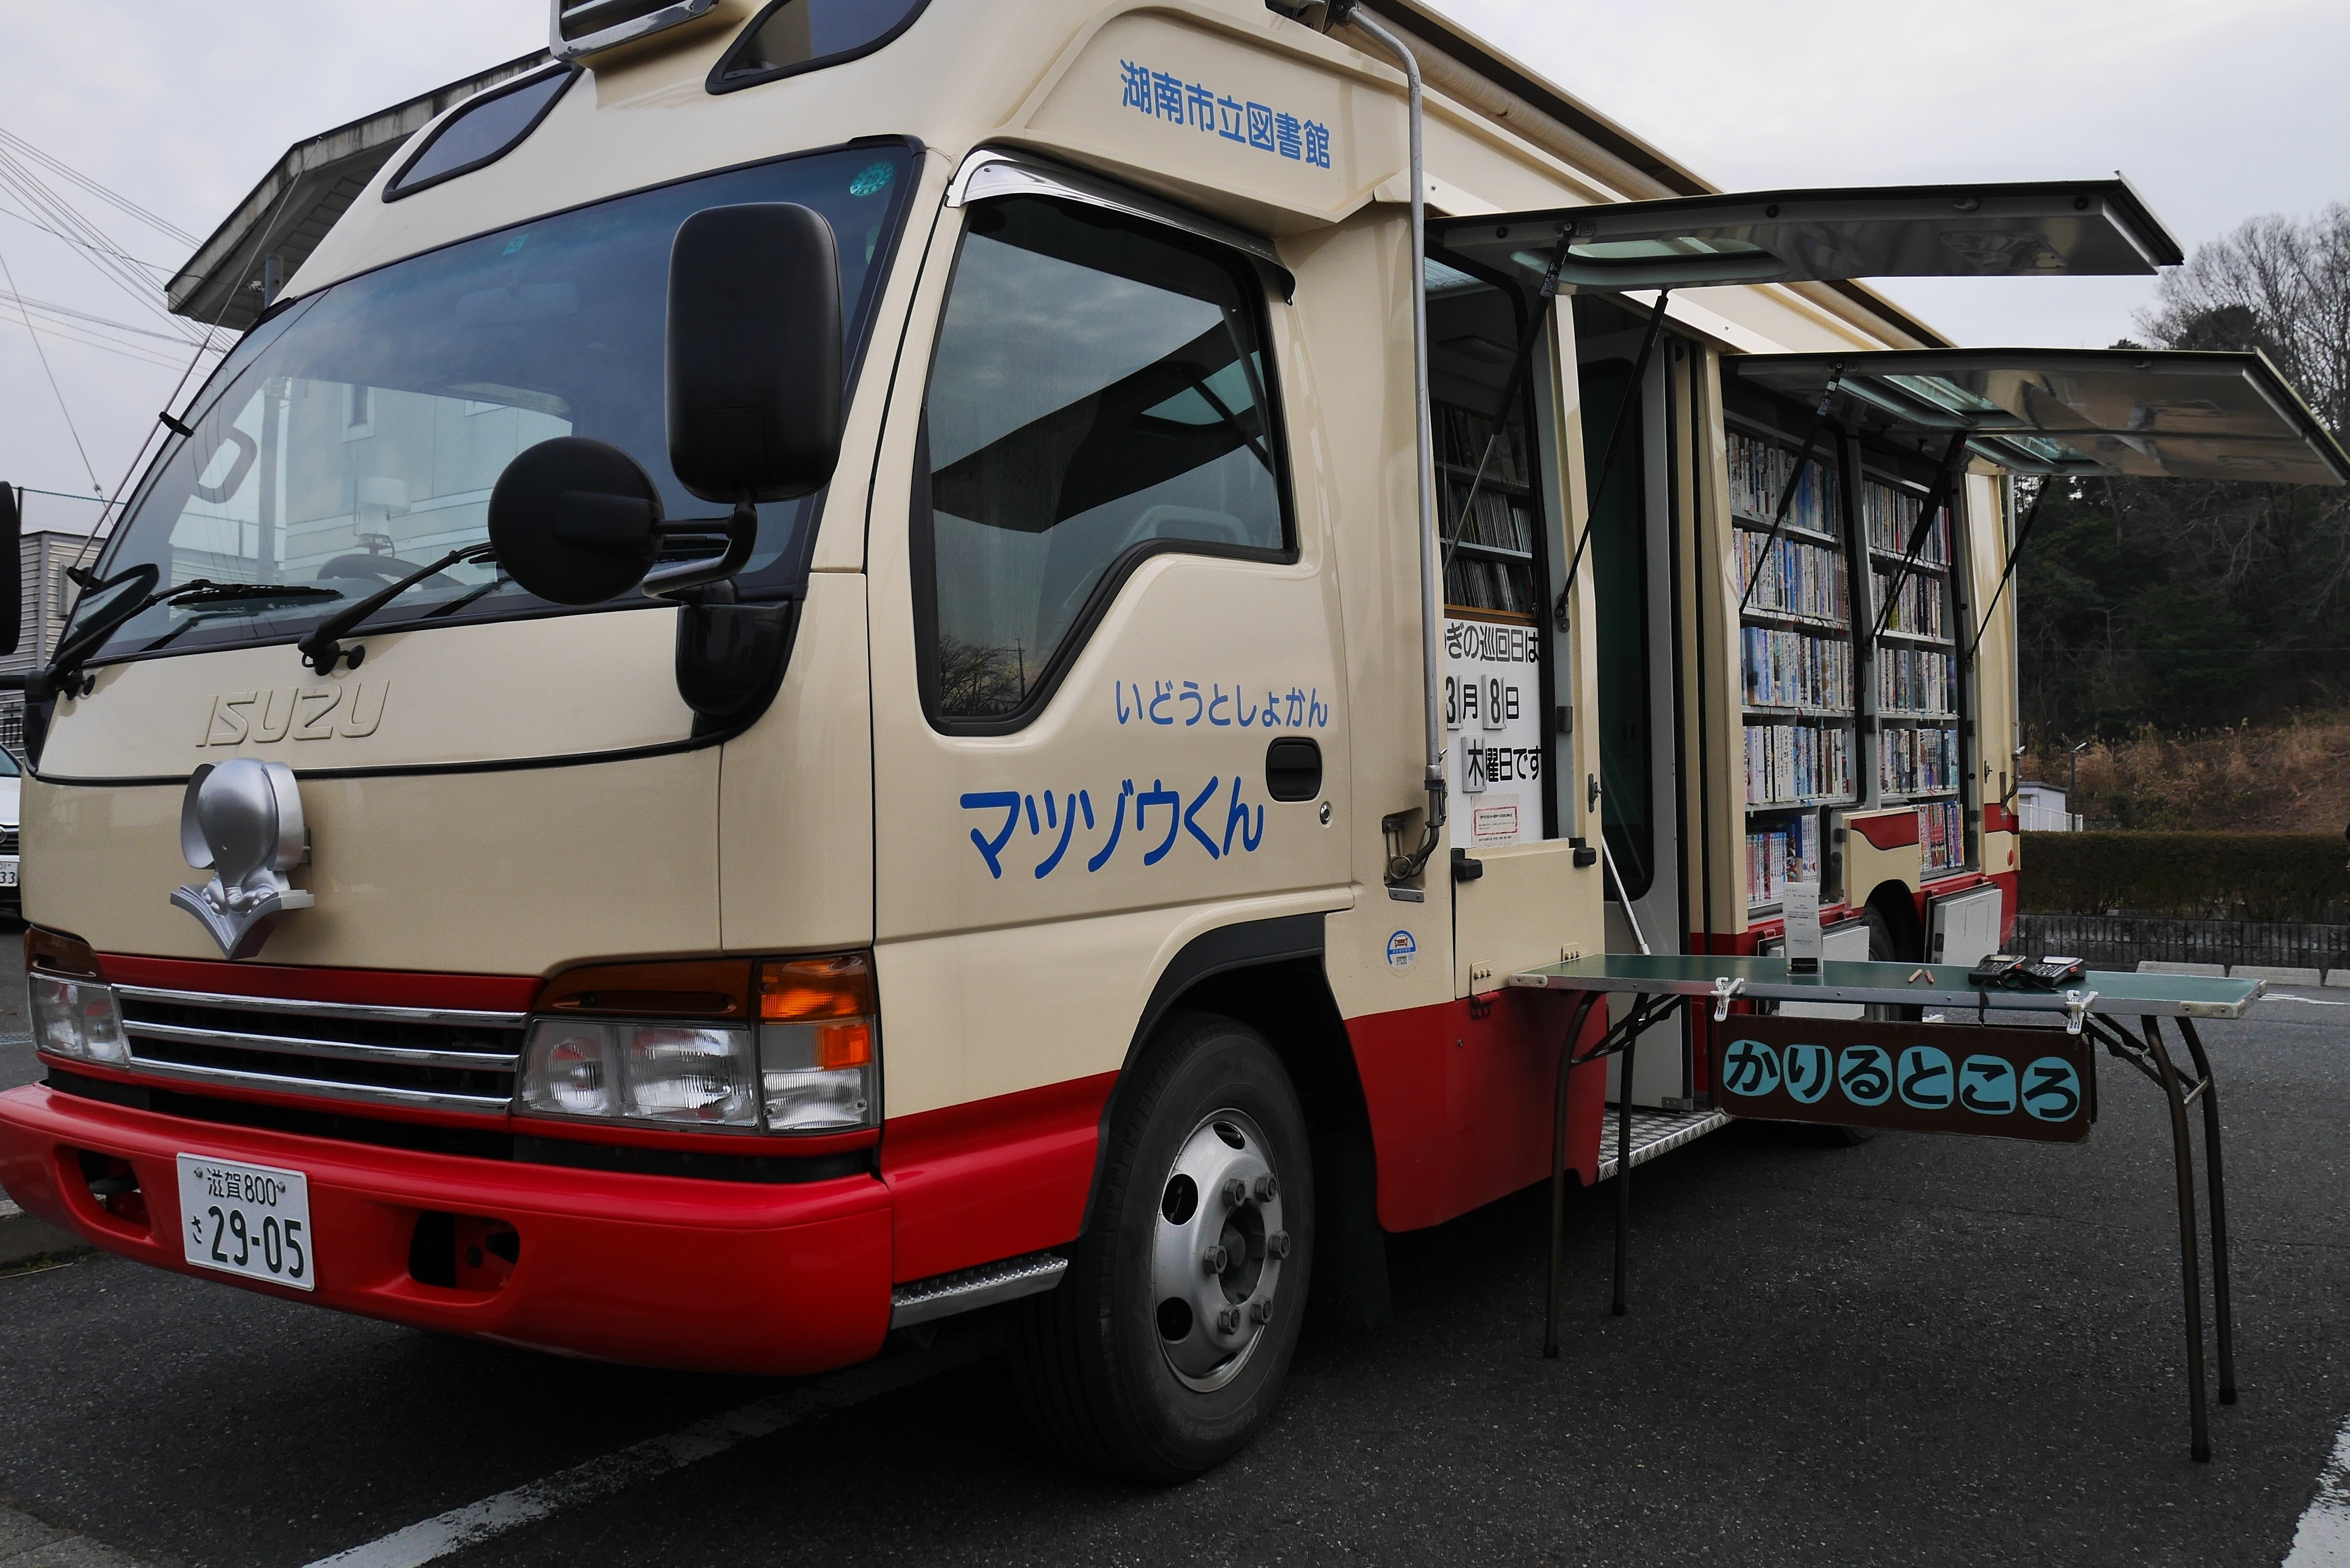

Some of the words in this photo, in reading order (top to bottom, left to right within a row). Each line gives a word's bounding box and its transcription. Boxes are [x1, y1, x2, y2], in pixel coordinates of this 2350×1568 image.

[1120, 59, 1331, 169] 湖南市立図書館
[1444, 621, 1539, 663] ぎの巡回日は
[195, 680, 390, 748] ISUZU
[1116, 680, 1328, 728] いどうとしょかん
[1468, 739, 1541, 787] 木曜日です
[960, 776, 1264, 879] マツゾウくん
[1725, 1042, 2079, 1118] かりるところ
[191, 1215, 202, 1244] さ
[208, 1205, 304, 1278] 29-05
